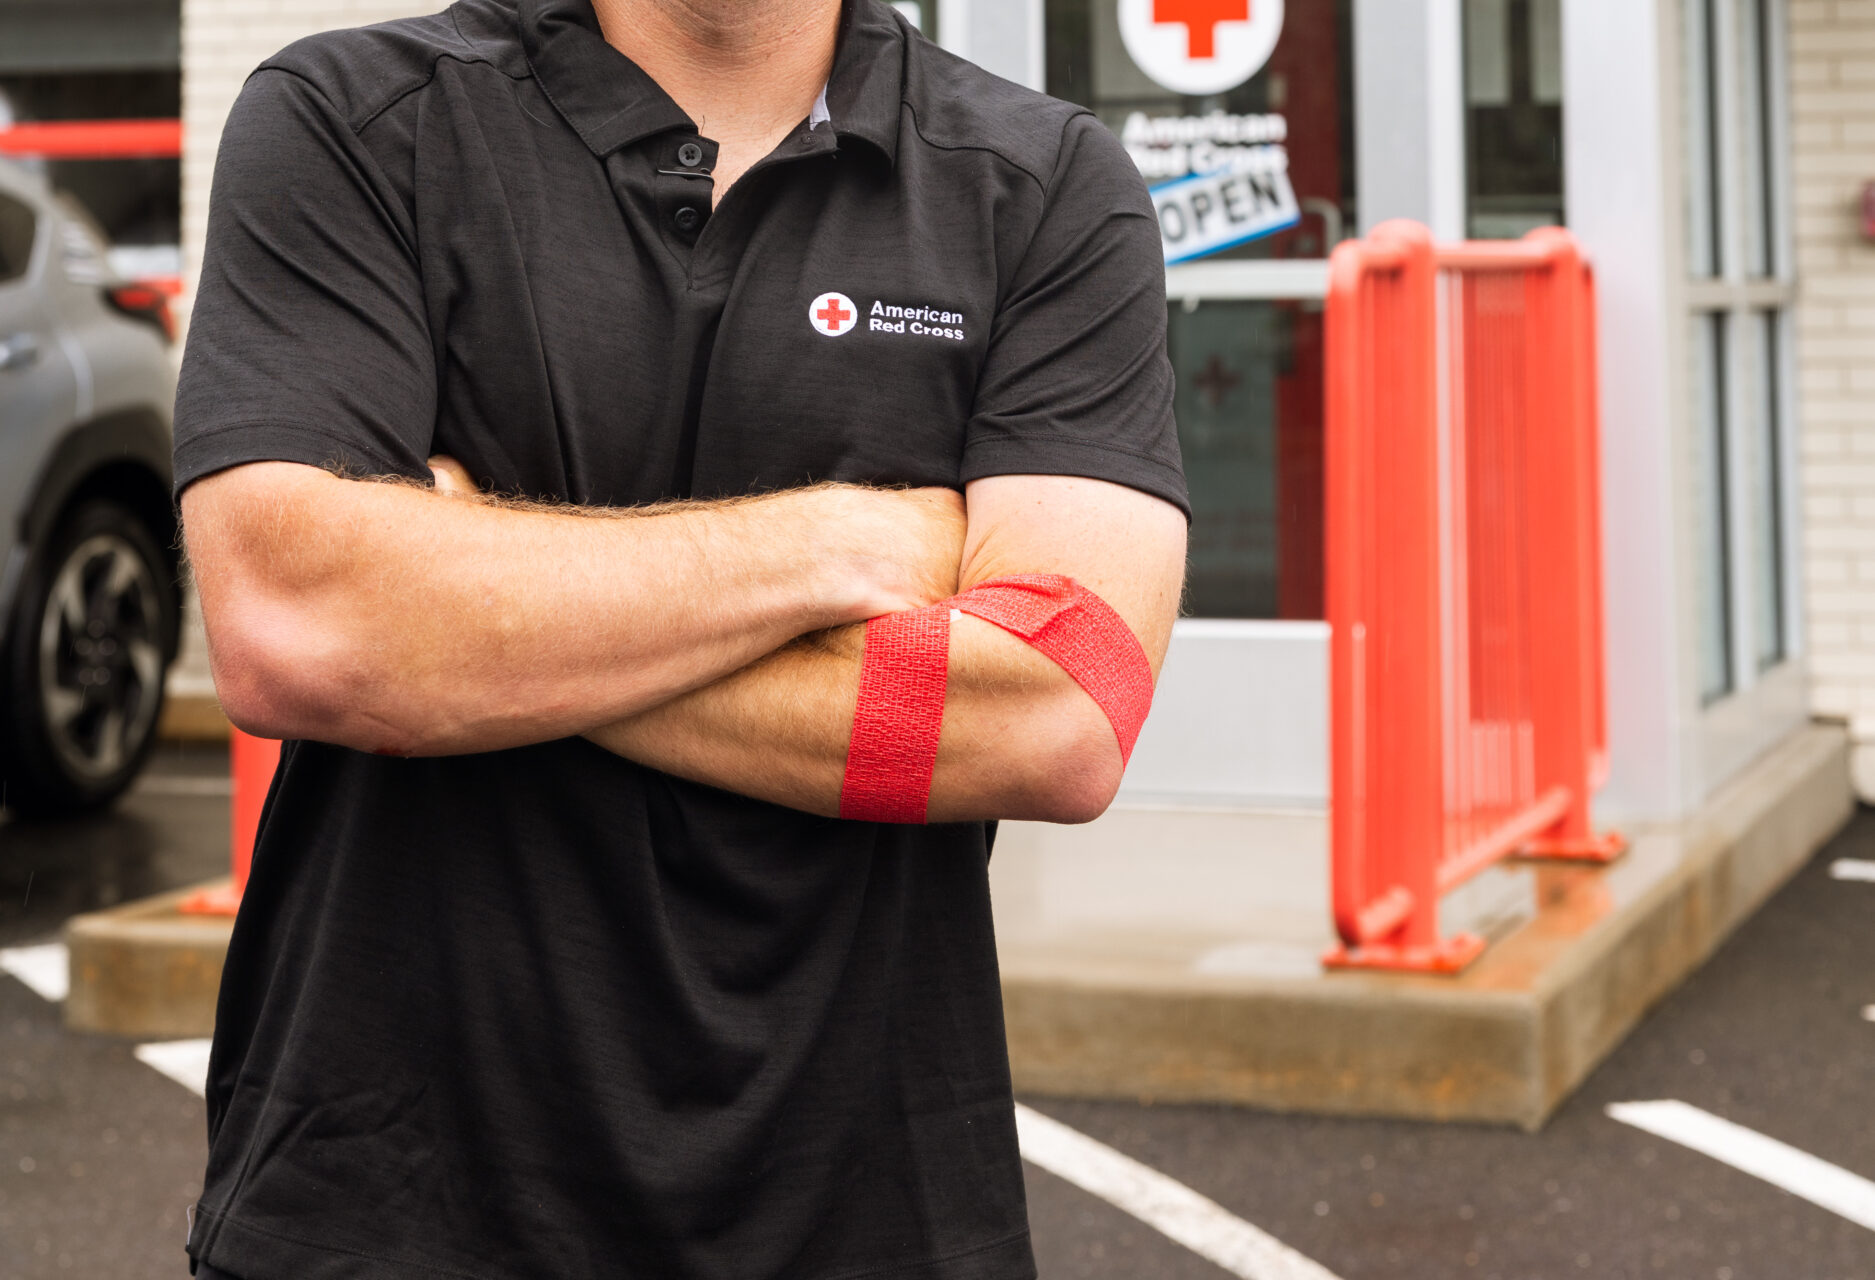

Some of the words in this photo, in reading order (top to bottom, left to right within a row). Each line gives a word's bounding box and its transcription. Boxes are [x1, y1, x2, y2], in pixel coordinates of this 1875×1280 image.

[1159, 170, 1282, 243] OPEN
[870, 300, 963, 324] American
[869, 318, 905, 334] Red
[910, 322, 964, 340] Cross
